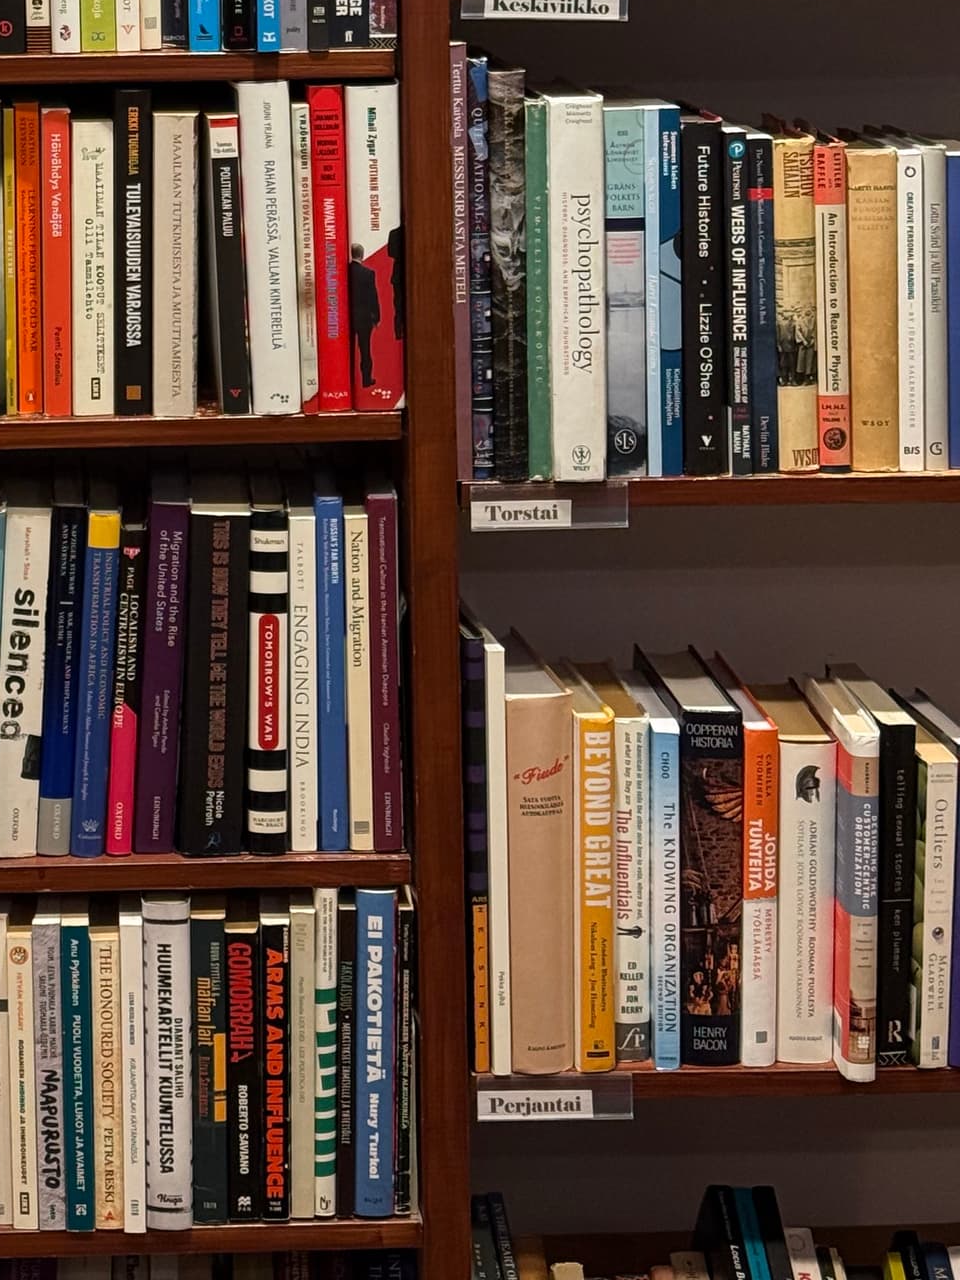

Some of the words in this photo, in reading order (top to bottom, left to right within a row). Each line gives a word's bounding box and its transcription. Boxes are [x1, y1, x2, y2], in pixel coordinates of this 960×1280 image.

[697, 146, 710, 192] Future
[698, 195, 711, 257] Histories
[571, 192, 603, 374] psychopathology
[699, 304, 712, 344] Lizzie
[699, 347, 713, 398] O'Shea
[485, 504, 559, 521] Torstai
[0, 587, 40, 740] silenced
[263, 623, 274, 709] TOMORROW'S
[263, 713, 272, 743] WAR
[686, 723, 739, 737] OOPPERAN
[690, 736, 734, 749] HISTORIA
[583, 731, 613, 830] BEYOND
[747, 820, 764, 892] TUNTEITA
[932, 798, 949, 871] Outliers
[583, 835, 613, 909] GREAT
[763, 833, 777, 892] JOHDA
[367, 915, 384, 938] EI
[265, 948, 284, 1020] ARMS
[366, 944, 386, 1084] PAKOTIETÄ
[692, 1026, 728, 1040] HENRY
[265, 1024, 284, 1076] AND
[692, 1038, 728, 1052] BACON
[488, 1095, 583, 1116] Perjantai
[266, 1080, 284, 1200] INFLUENCE
